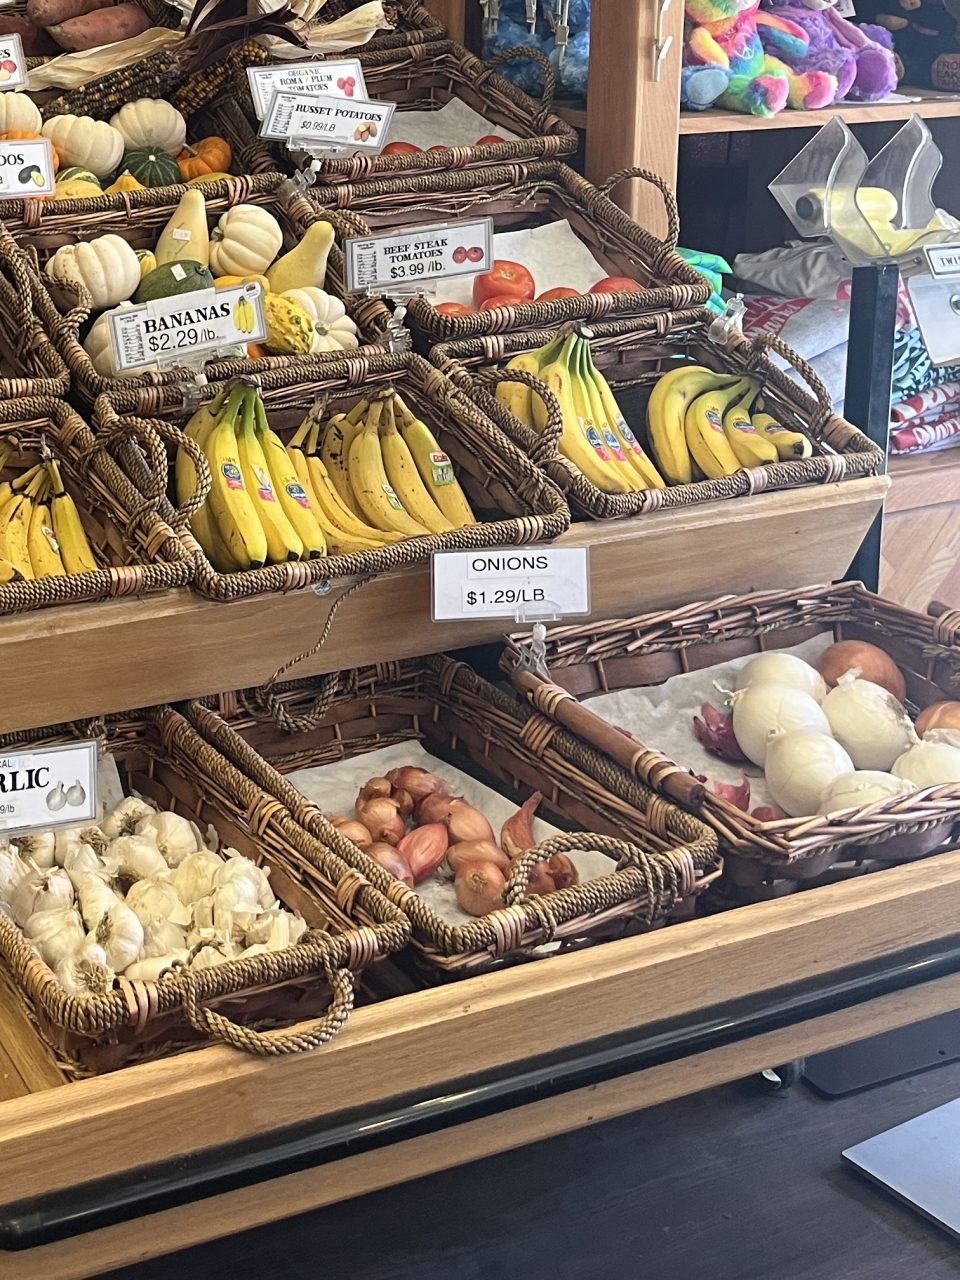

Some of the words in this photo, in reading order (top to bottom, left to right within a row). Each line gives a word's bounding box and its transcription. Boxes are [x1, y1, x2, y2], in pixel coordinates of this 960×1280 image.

[280, 77, 303, 86] ROMA
[311, 74, 334, 84] PLUM
[295, 104, 334, 116] RUSSET
[335, 109, 383, 122] POTATOES
[383, 244, 410, 256] BEEF
[414, 238, 448, 252] STEAK
[389, 249, 444, 264] TOMATOES
[390, 264, 425, 280] $3.99
[143, 302, 230, 334] BANANAS
[472, 556, 548, 572] ONIONS
[466, 588, 546, 606] $1.29/LB
